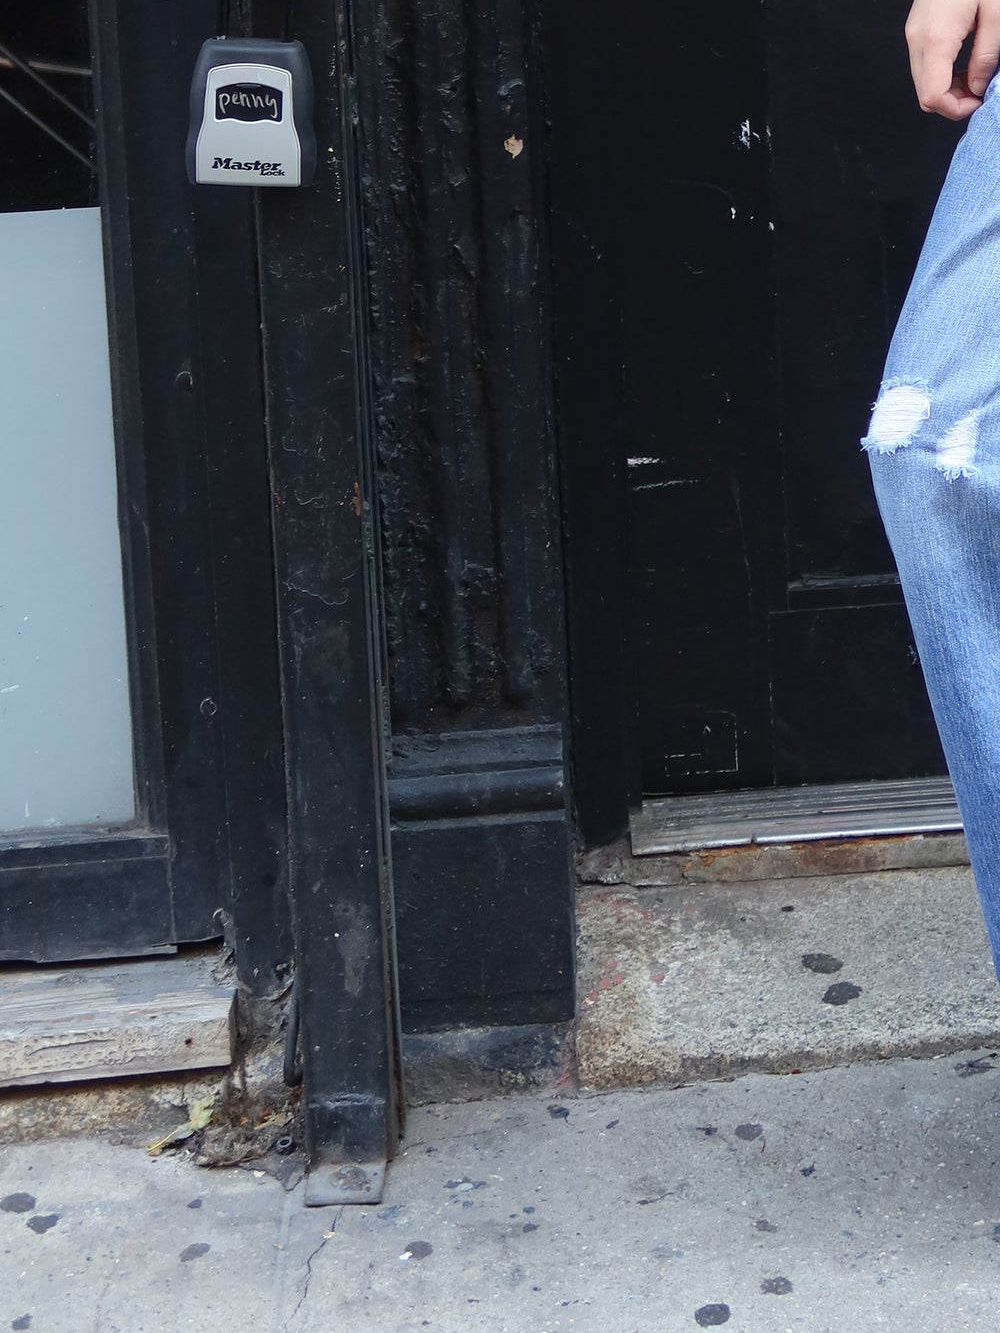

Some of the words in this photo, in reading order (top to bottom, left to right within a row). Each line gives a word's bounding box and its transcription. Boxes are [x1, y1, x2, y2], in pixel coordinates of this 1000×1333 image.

[218, 91, 279, 119] penny
[211, 157, 282, 171] Master
[259, 169, 286, 177] Lock
